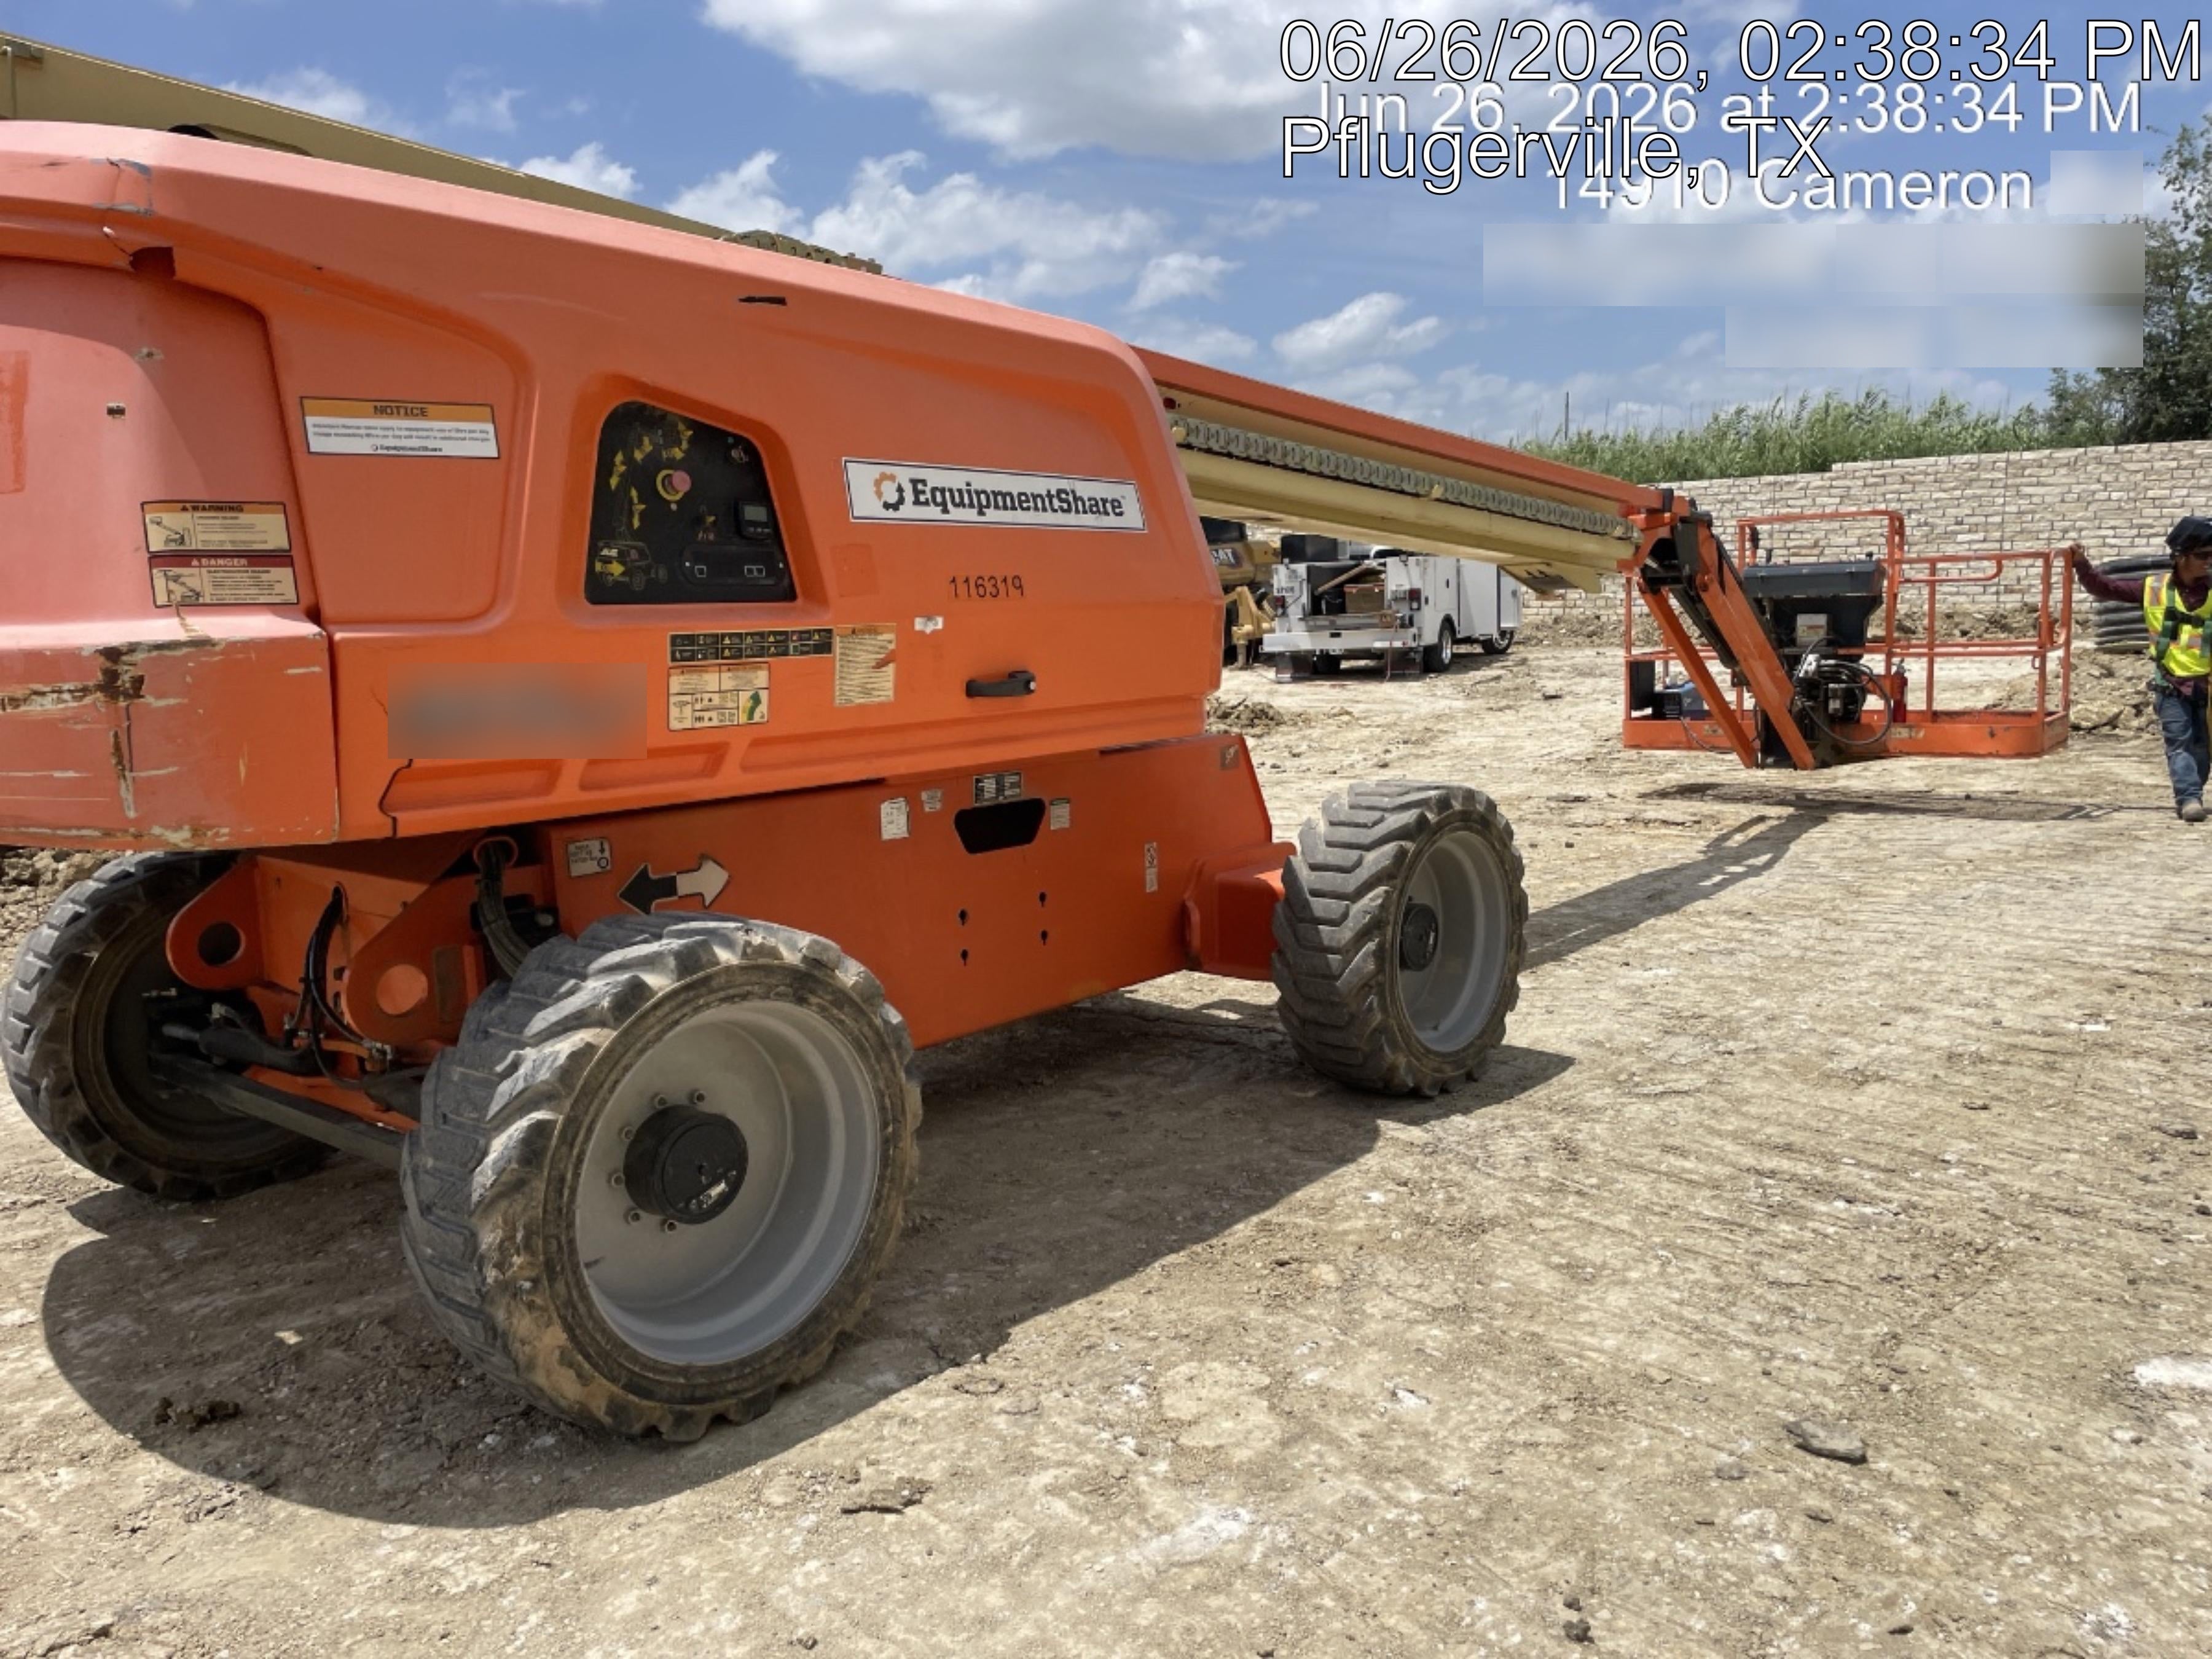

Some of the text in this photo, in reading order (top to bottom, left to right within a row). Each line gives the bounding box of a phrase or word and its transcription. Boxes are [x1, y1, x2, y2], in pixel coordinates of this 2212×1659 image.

[374, 404, 428, 417] NOTICE
[909, 477, 1124, 517] EquipmentShare
[201, 558, 247, 567] DANGER
[949, 575, 1024, 598] 116319
